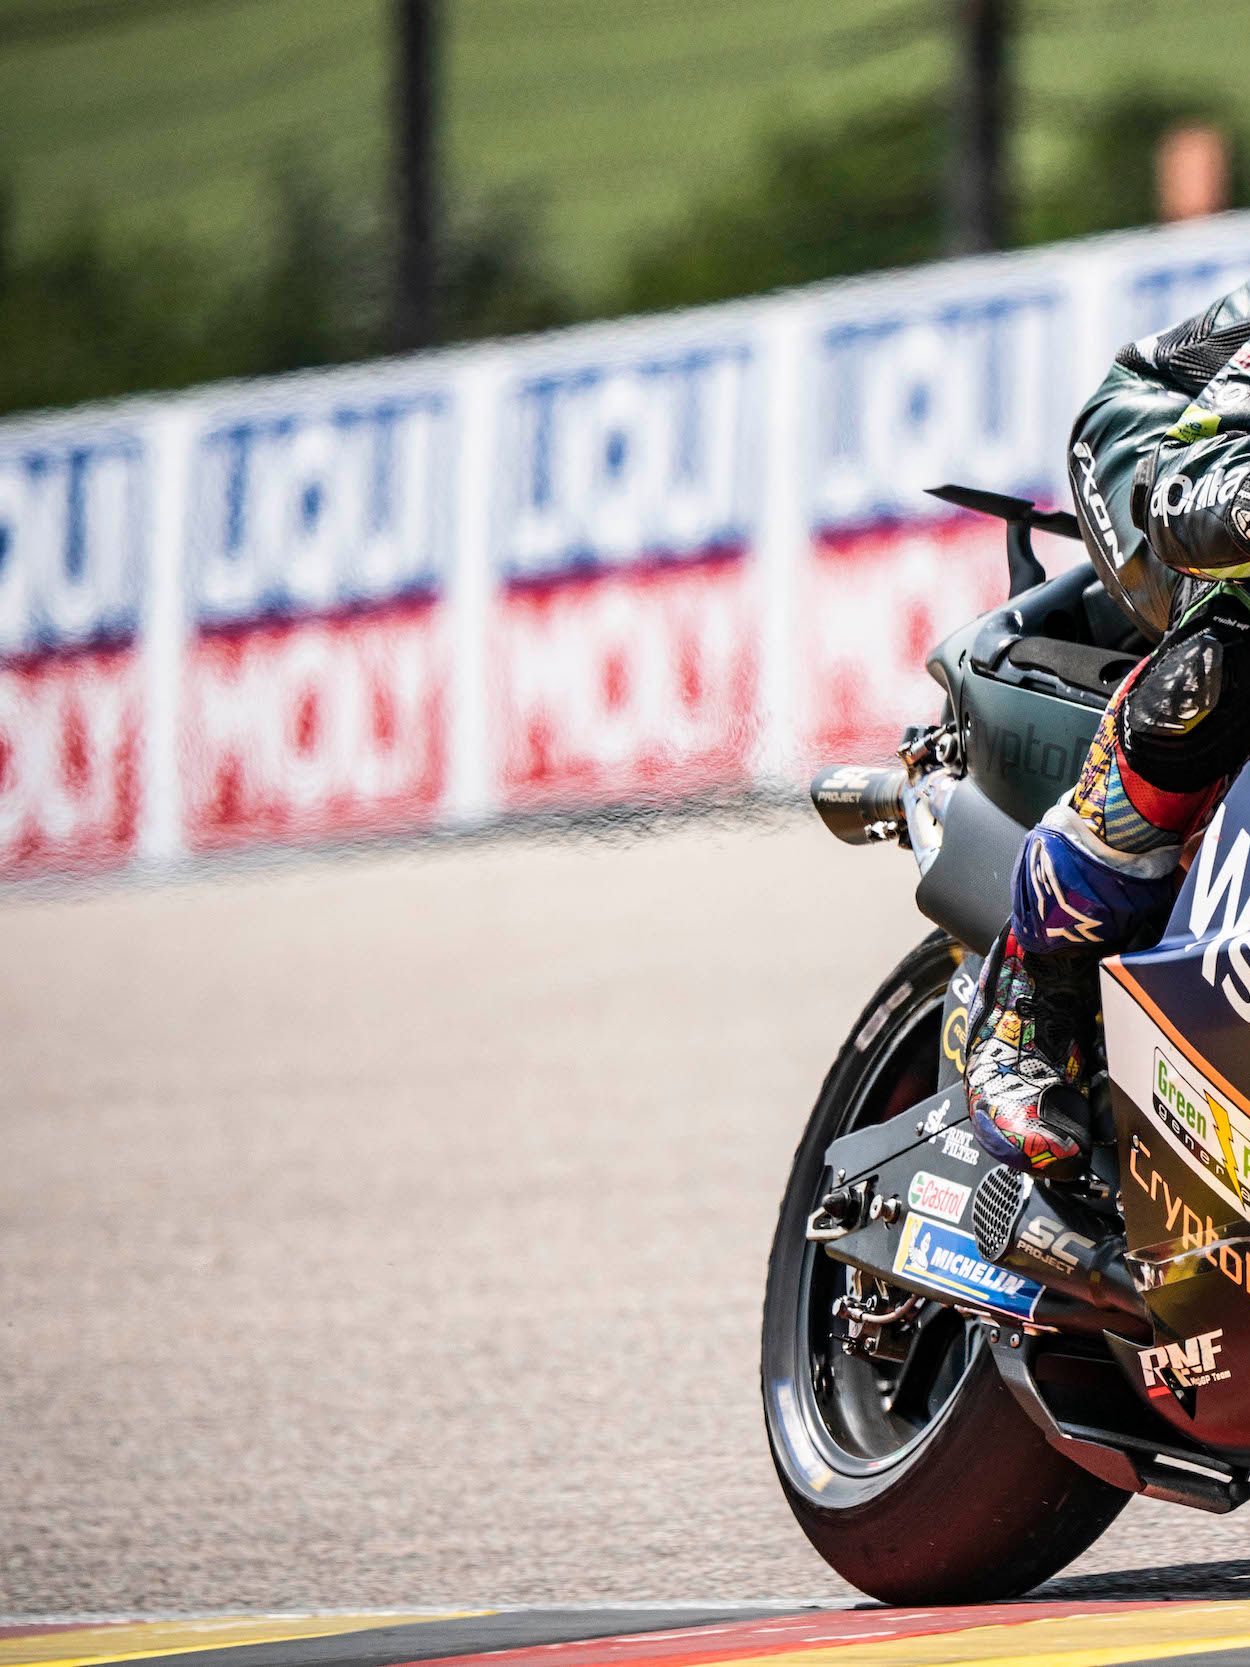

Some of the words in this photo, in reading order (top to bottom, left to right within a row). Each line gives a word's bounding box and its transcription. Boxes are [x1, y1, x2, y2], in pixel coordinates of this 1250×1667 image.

[1150, 466, 1250, 528] aprilia
[817, 791, 863, 804] PROJECT
[1157, 1059, 1208, 1140] Green
[941, 1139, 980, 1166] FILTER
[921, 1180, 966, 1218] Castrol
[1017, 1239, 1076, 1275] PROJECT
[1020, 1215, 1097, 1266] SC
[929, 1246, 1027, 1295] MICHELIN
